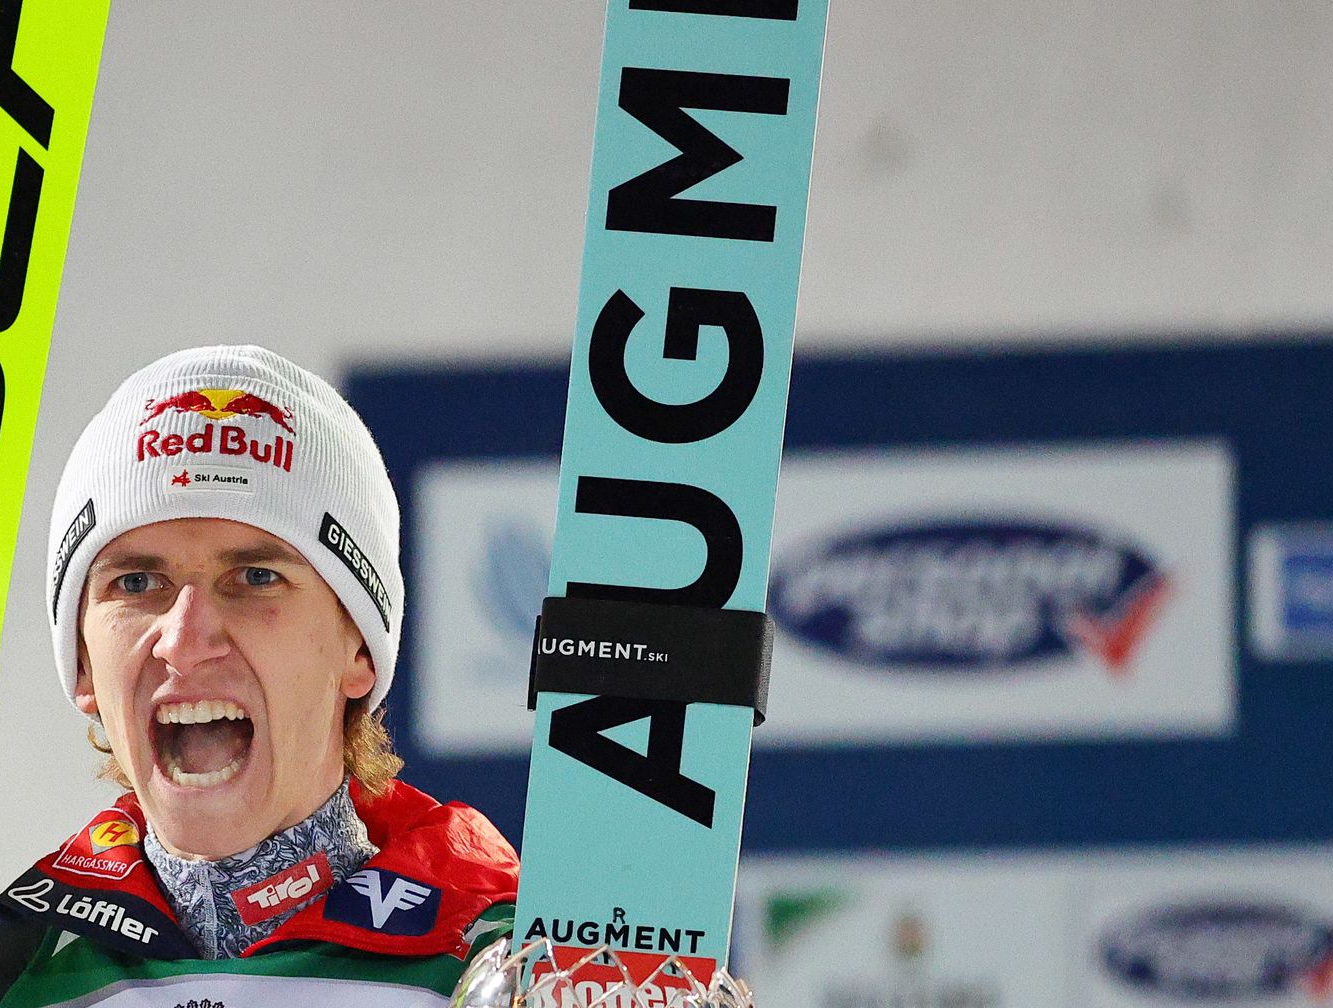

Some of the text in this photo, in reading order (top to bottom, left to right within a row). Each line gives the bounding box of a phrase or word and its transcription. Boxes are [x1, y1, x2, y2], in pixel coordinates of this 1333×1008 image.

[137, 423, 294, 472] Red Bull
[194, 473, 249, 485] Ski Austria
[538, 637, 669, 662] UGMENT.SKI
[61, 853, 128, 874] HARGASSNER
[246, 864, 322, 909] Tirol
[524, 916, 706, 954] AUGMENT
